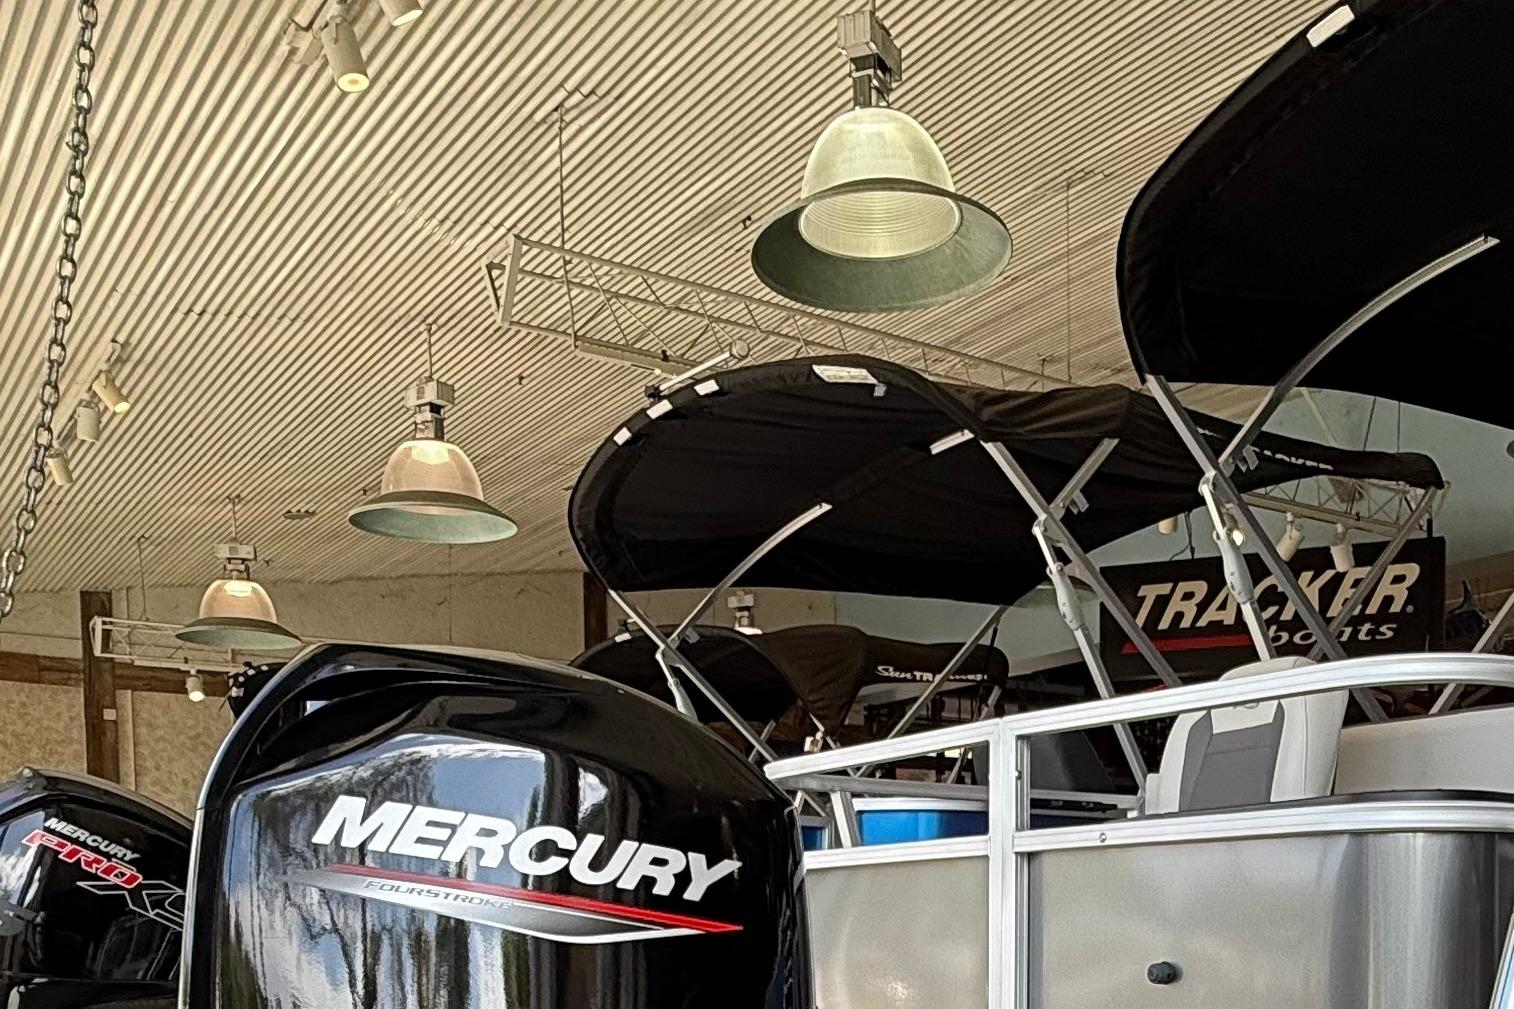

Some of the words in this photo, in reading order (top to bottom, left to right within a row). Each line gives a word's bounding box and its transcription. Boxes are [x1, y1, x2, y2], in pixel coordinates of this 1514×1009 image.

[1269, 621, 1398, 647] bots
[21, 829, 143, 889] PRO
[44, 817, 141, 861] MERCURY
[311, 794, 743, 902] MERCURY
[364, 880, 513, 910] FOURSTROKE
